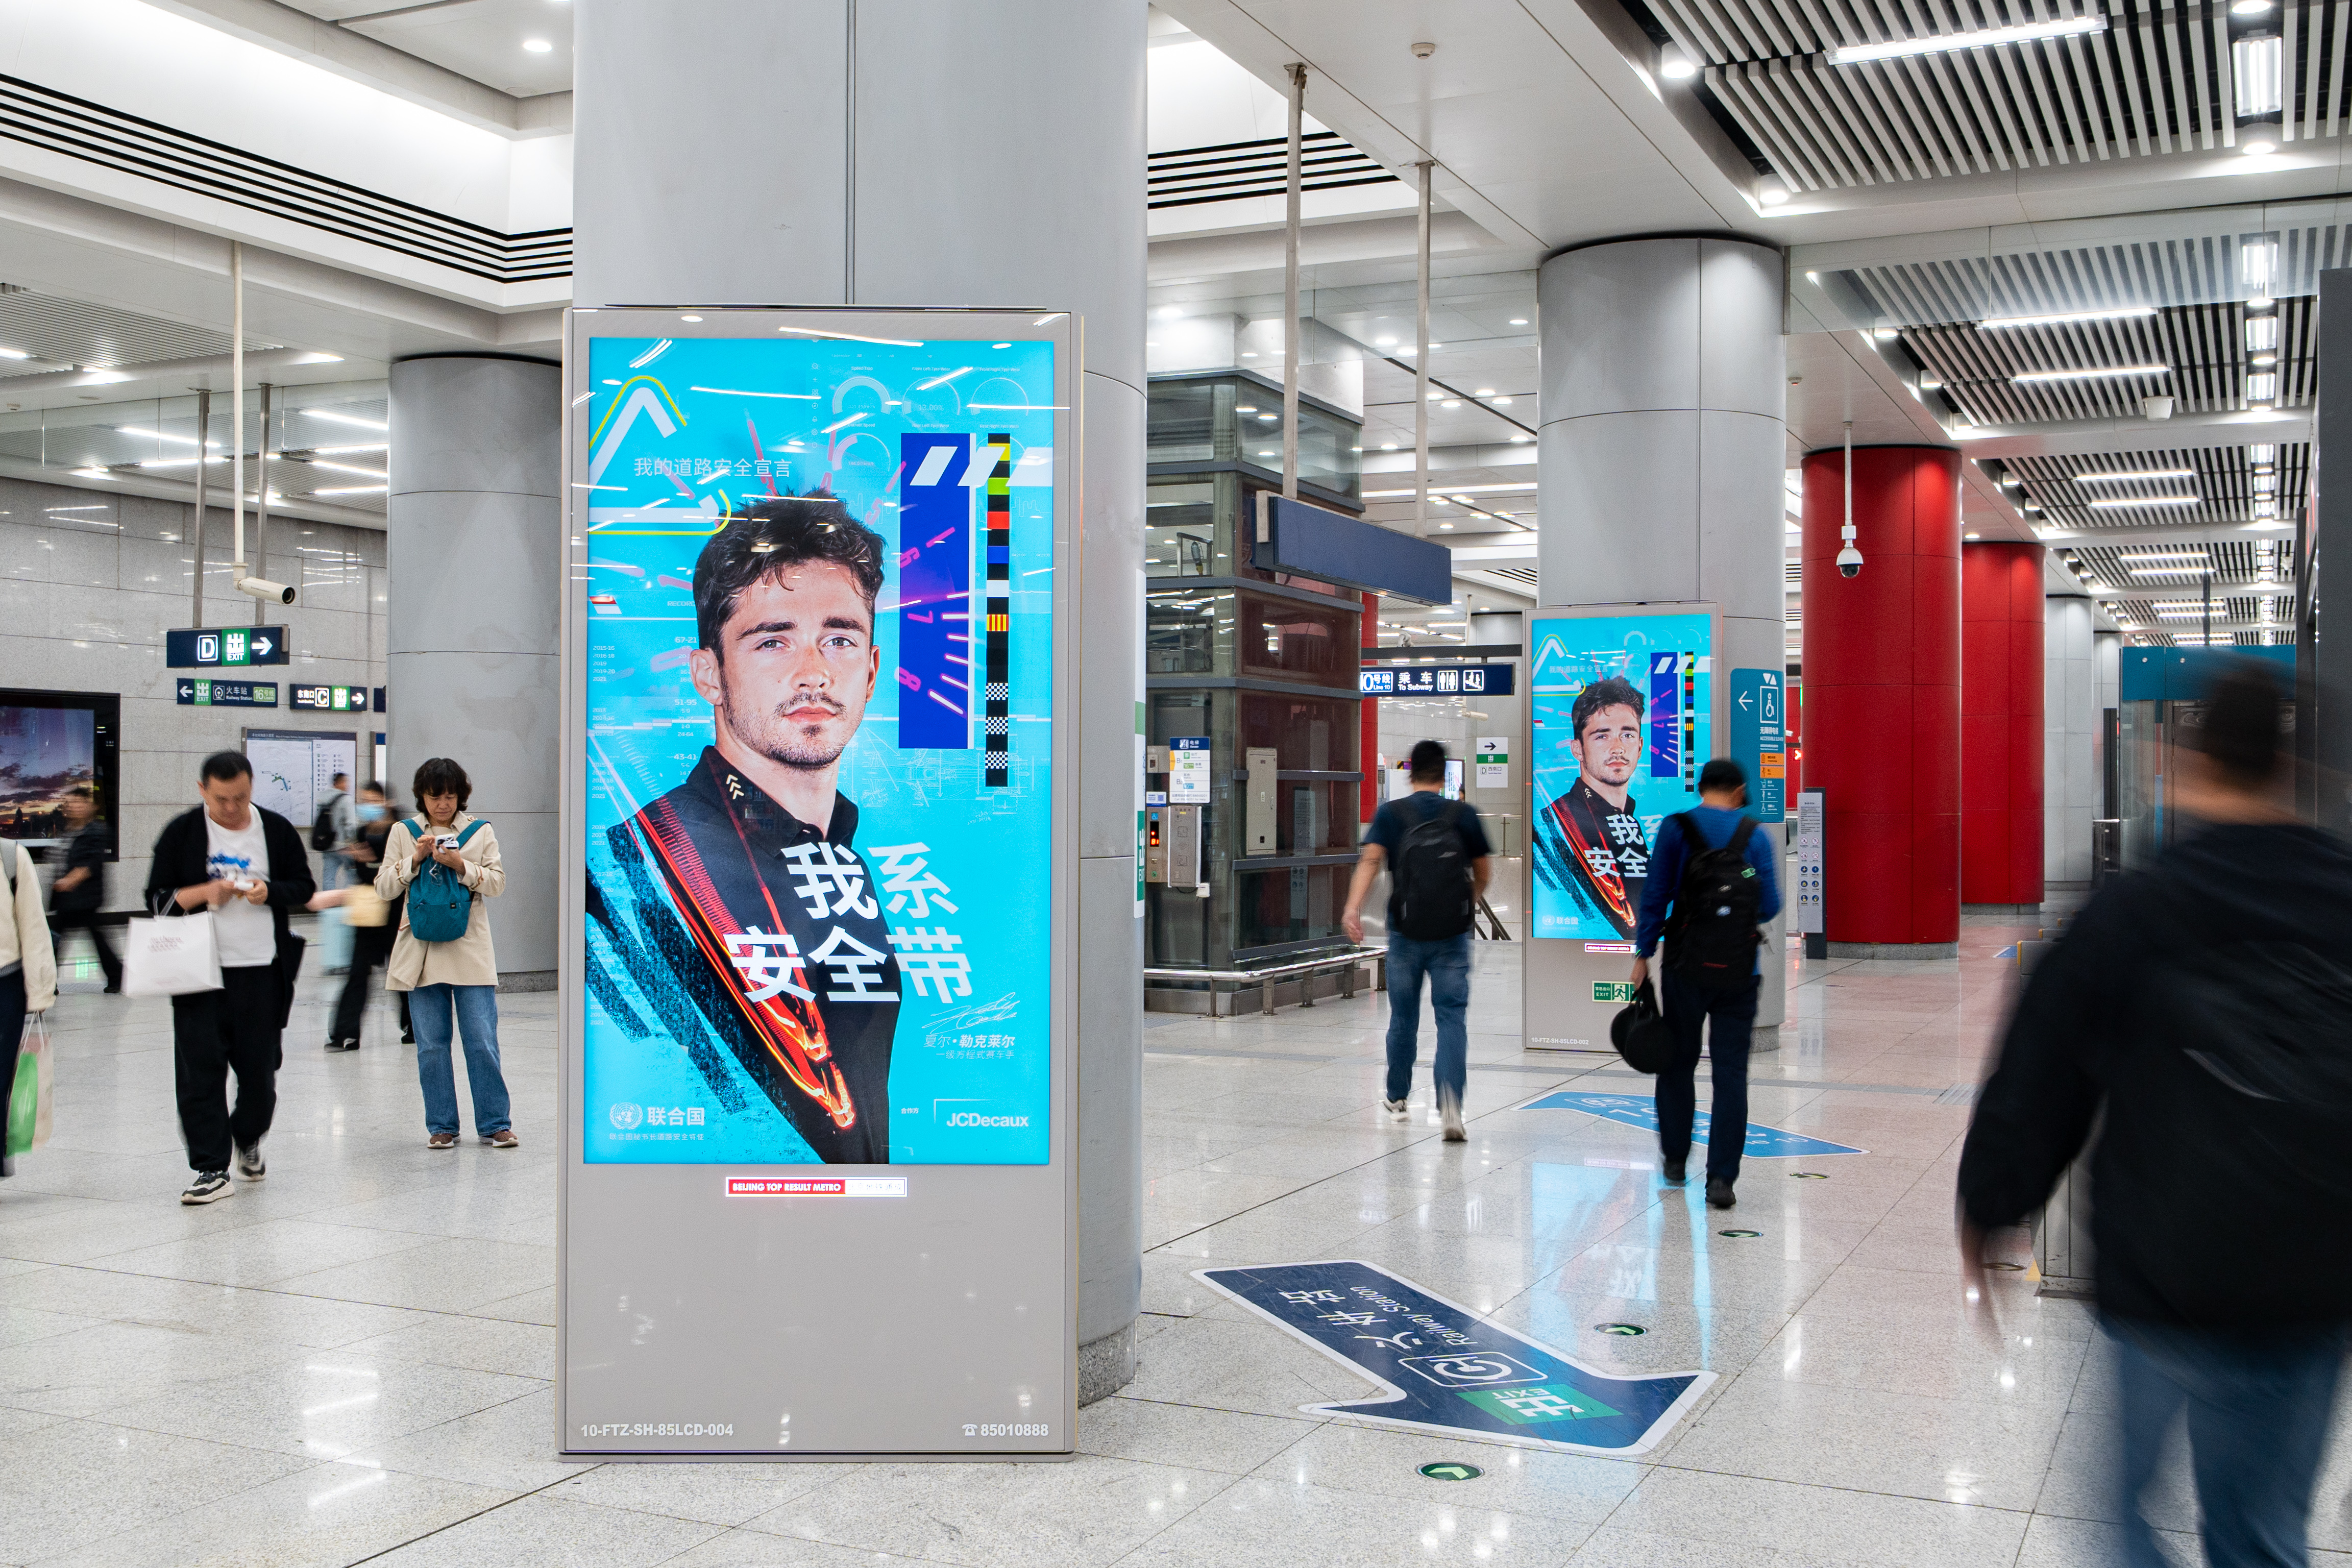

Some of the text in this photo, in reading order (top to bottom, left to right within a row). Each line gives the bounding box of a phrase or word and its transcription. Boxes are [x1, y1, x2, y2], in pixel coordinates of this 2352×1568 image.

[633, 457, 793, 478] 我的道路安全宣言
[202, 639, 215, 658] D
[227, 633, 244, 653] 出
[1549, 665, 1608, 673] 我的道路安全宣言
[197, 682, 209, 696] 出
[226, 687, 248, 695] 火车站
[334, 689, 347, 702] 出
[317, 690, 327, 704] C
[781, 841, 959, 919] 我系
[1556, 916, 1578, 925] 联合国
[723, 925, 973, 1004] 安全带
[1531, 1037, 1589, 1045] 10-FTZ-SH-85LCD-002
[936, 1049, 1015, 1060] 一级方程式赛车手
[647, 1106, 705, 1126] 联合国
[946, 1113, 1029, 1127] JCDecaux
[732, 1183, 841, 1192] BEIJING TOP RESULT METRO
[1350, 1286, 1478, 1346] Railway Station
[1491, 1388, 1552, 1400] EXIT
[581, 1423, 734, 1437] 10-FTZ-SH-85LCD-004
[981, 1423, 1049, 1436] 85010888
